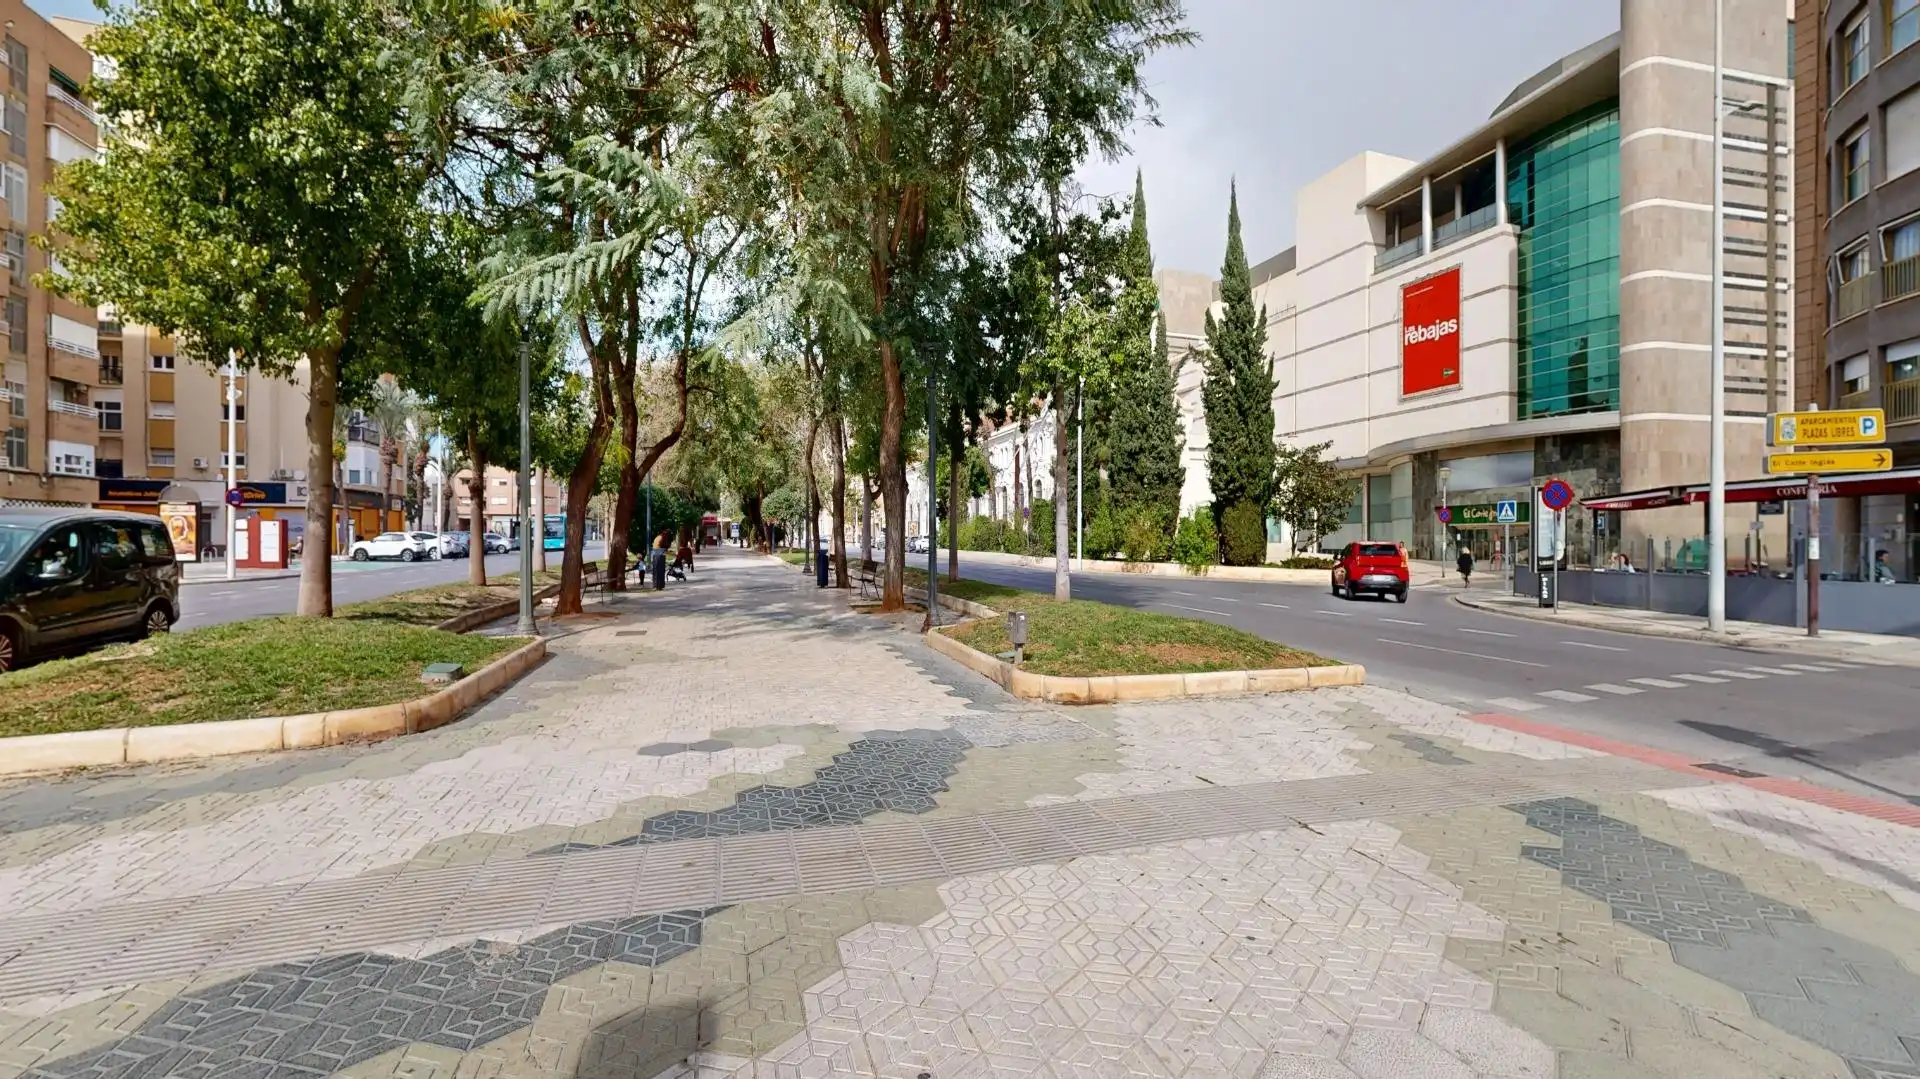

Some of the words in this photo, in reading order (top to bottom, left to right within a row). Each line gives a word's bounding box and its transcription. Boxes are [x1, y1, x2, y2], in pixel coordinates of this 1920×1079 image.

[1404, 318, 1457, 346] rebajas
[1800, 416, 1857, 425] APARCAMIENTOS
[1862, 418, 1874, 433] P
[1802, 427, 1828, 438] PLAZAS
[1831, 426, 1855, 437] LIBRES
[1776, 483, 1837, 496] CONFITRÍA
[1463, 508, 1471, 518] El
